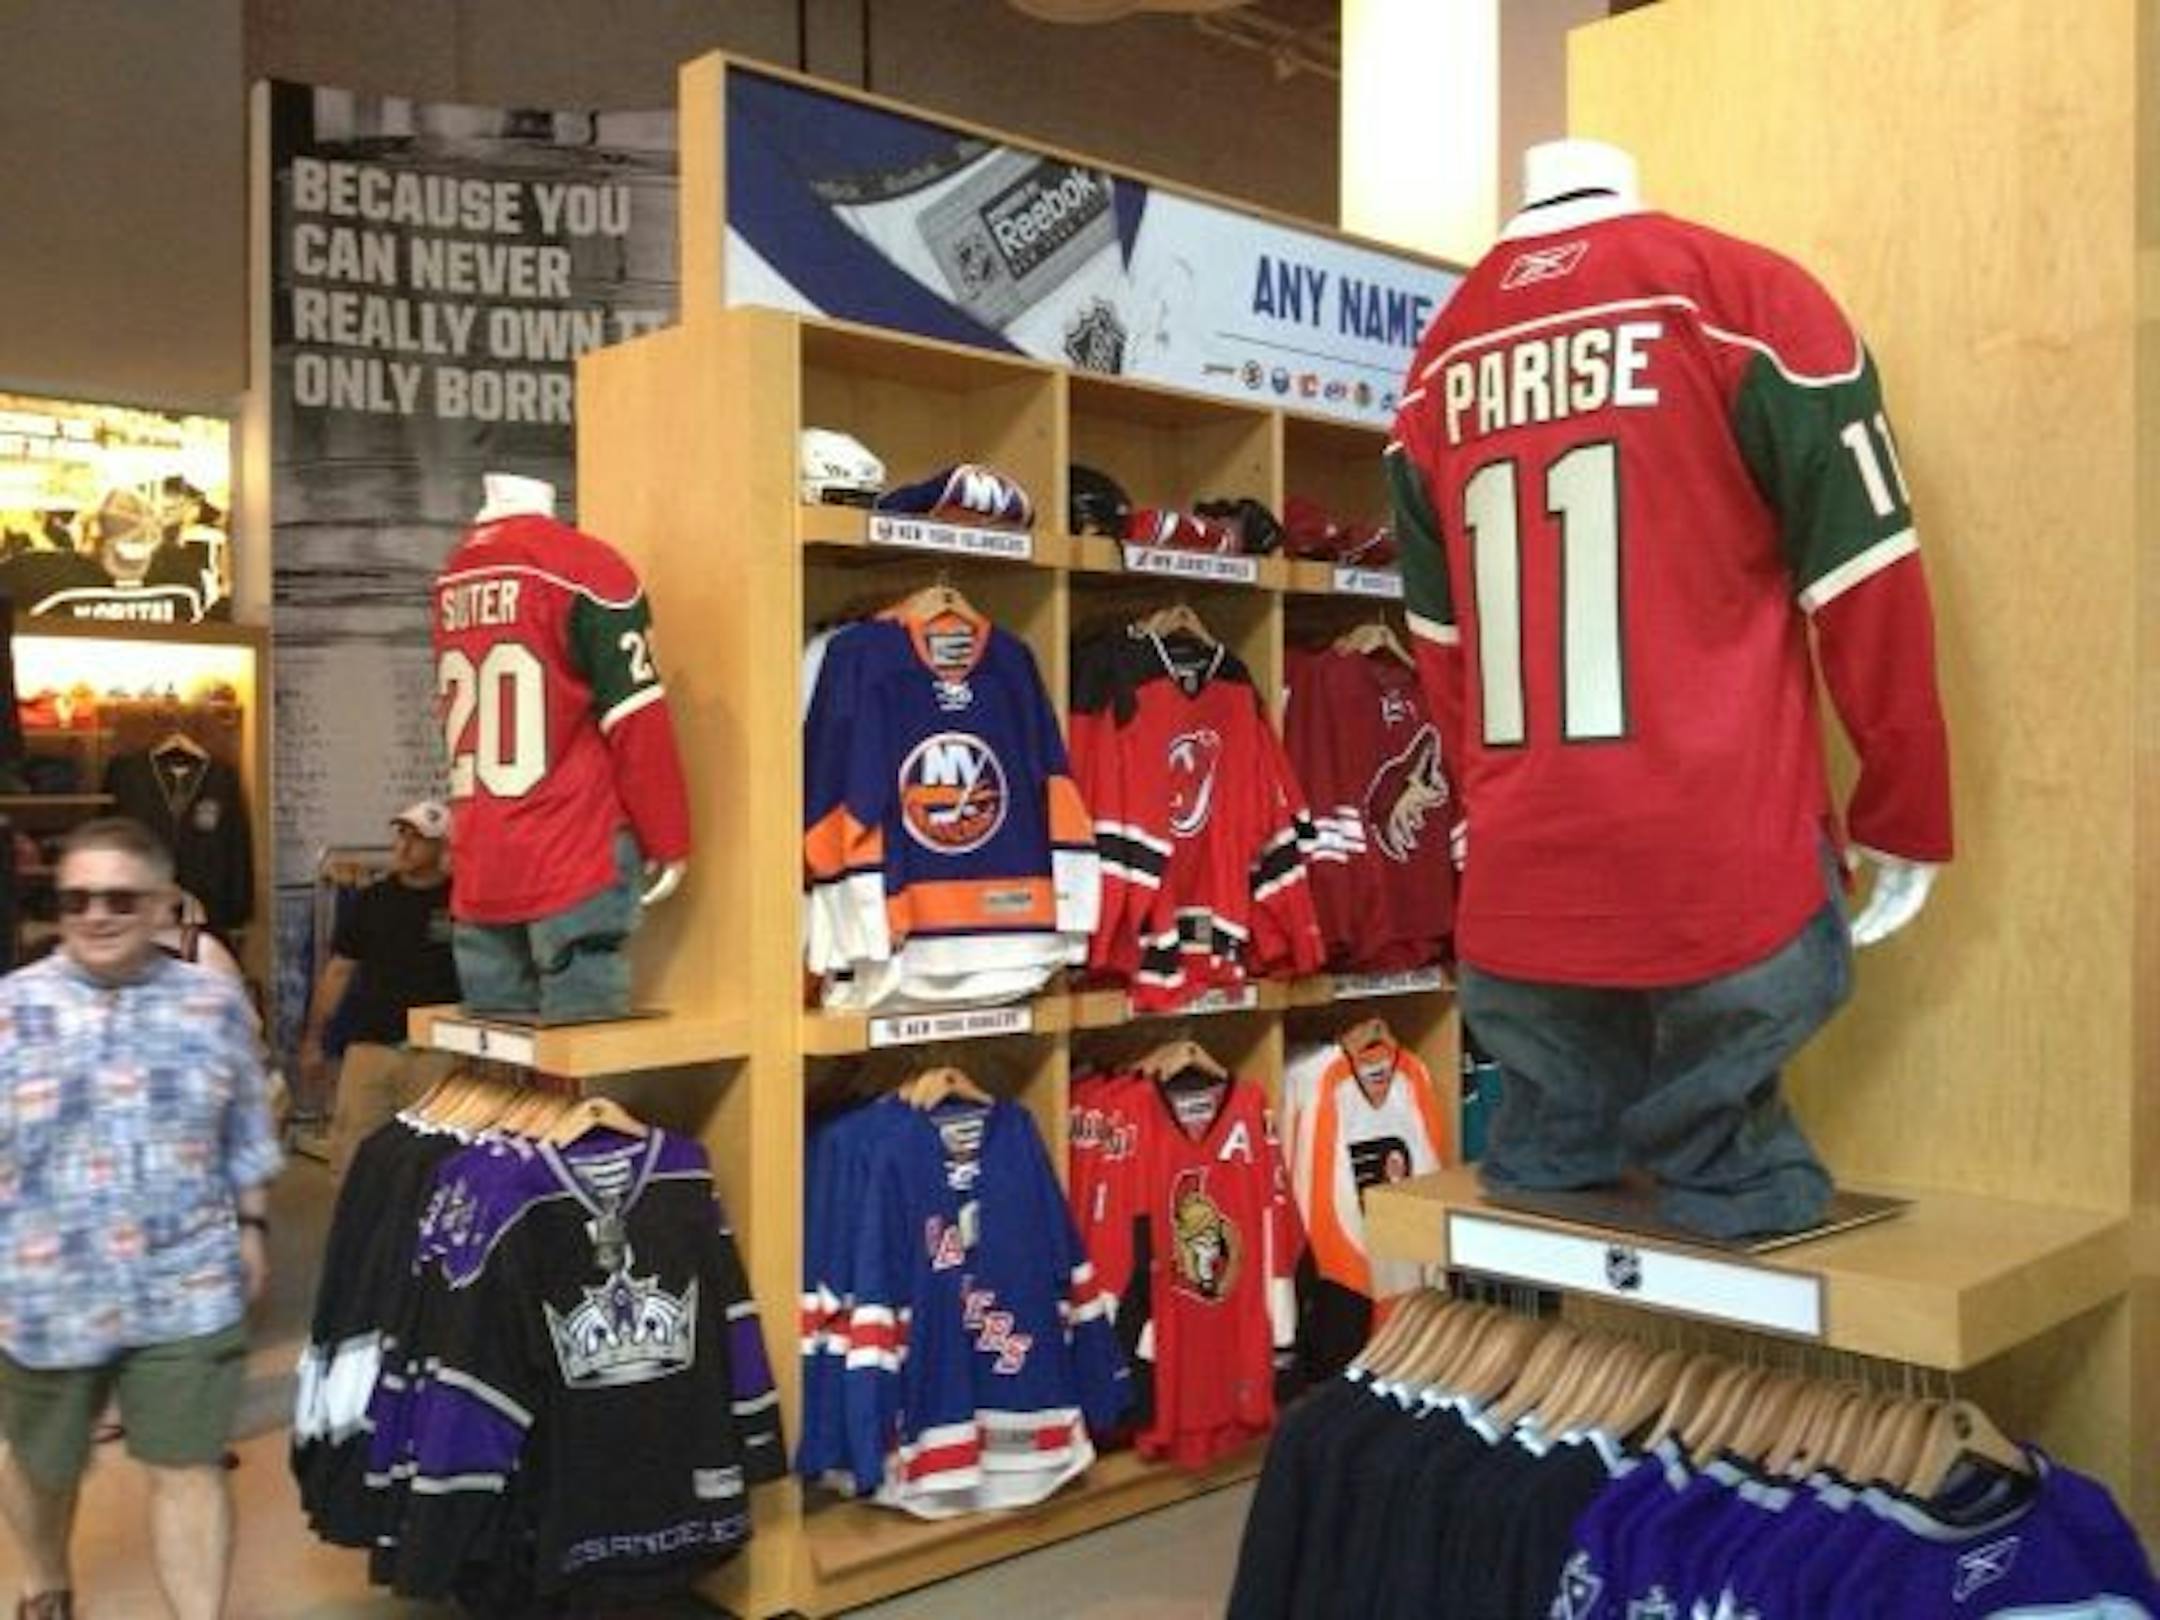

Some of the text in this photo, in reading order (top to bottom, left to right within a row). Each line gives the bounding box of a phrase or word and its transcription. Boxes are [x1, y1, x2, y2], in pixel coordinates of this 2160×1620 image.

[293, 156, 631, 237] BECAUSE YOU
[992, 167, 1097, 256] Reebok
[294, 223, 572, 298] CAN NEVER
[294, 287, 476, 355] REALLY
[490, 307, 603, 361] OWN
[1253, 256, 1432, 349] ANY NAME
[295, 355, 572, 424] ONLY BORR
[1444, 320, 1664, 446] PARISE
[441, 578, 520, 632] SUTER
[1464, 438, 1628, 748] 11
[438, 641, 546, 798] 20
[921, 743, 990, 787] NY
[1217, 1120, 1253, 1163] A
